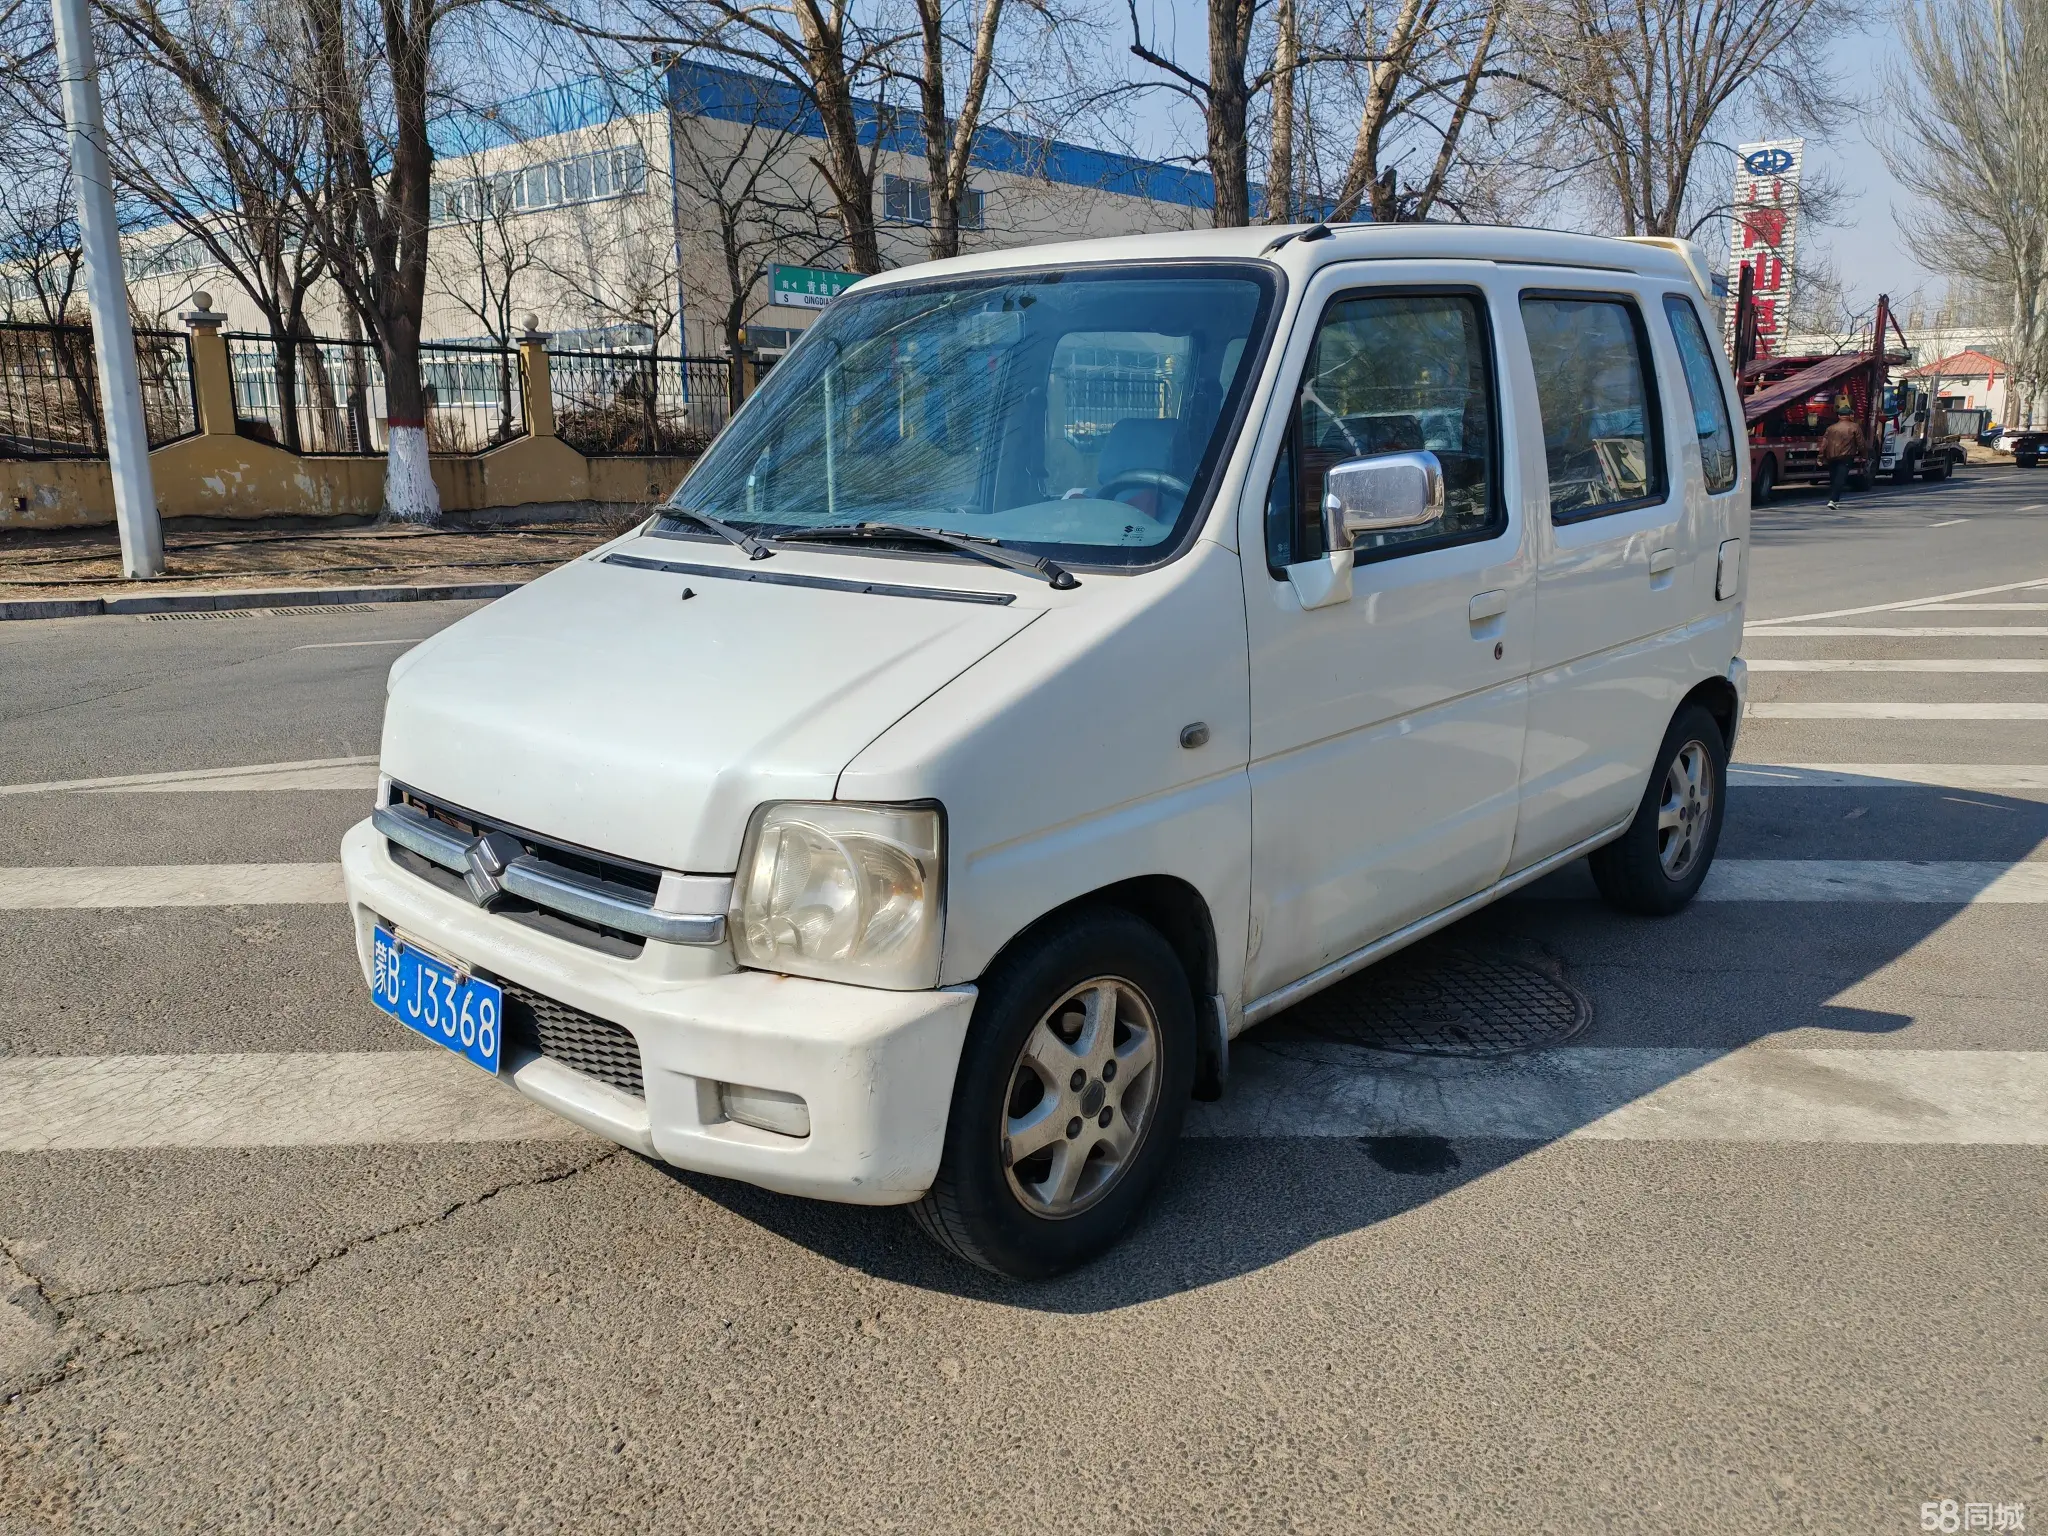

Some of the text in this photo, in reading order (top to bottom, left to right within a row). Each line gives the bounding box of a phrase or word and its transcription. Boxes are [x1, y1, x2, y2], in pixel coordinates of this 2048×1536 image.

[807, 281, 840, 295] 青电路
[783, 293, 789, 303] S
